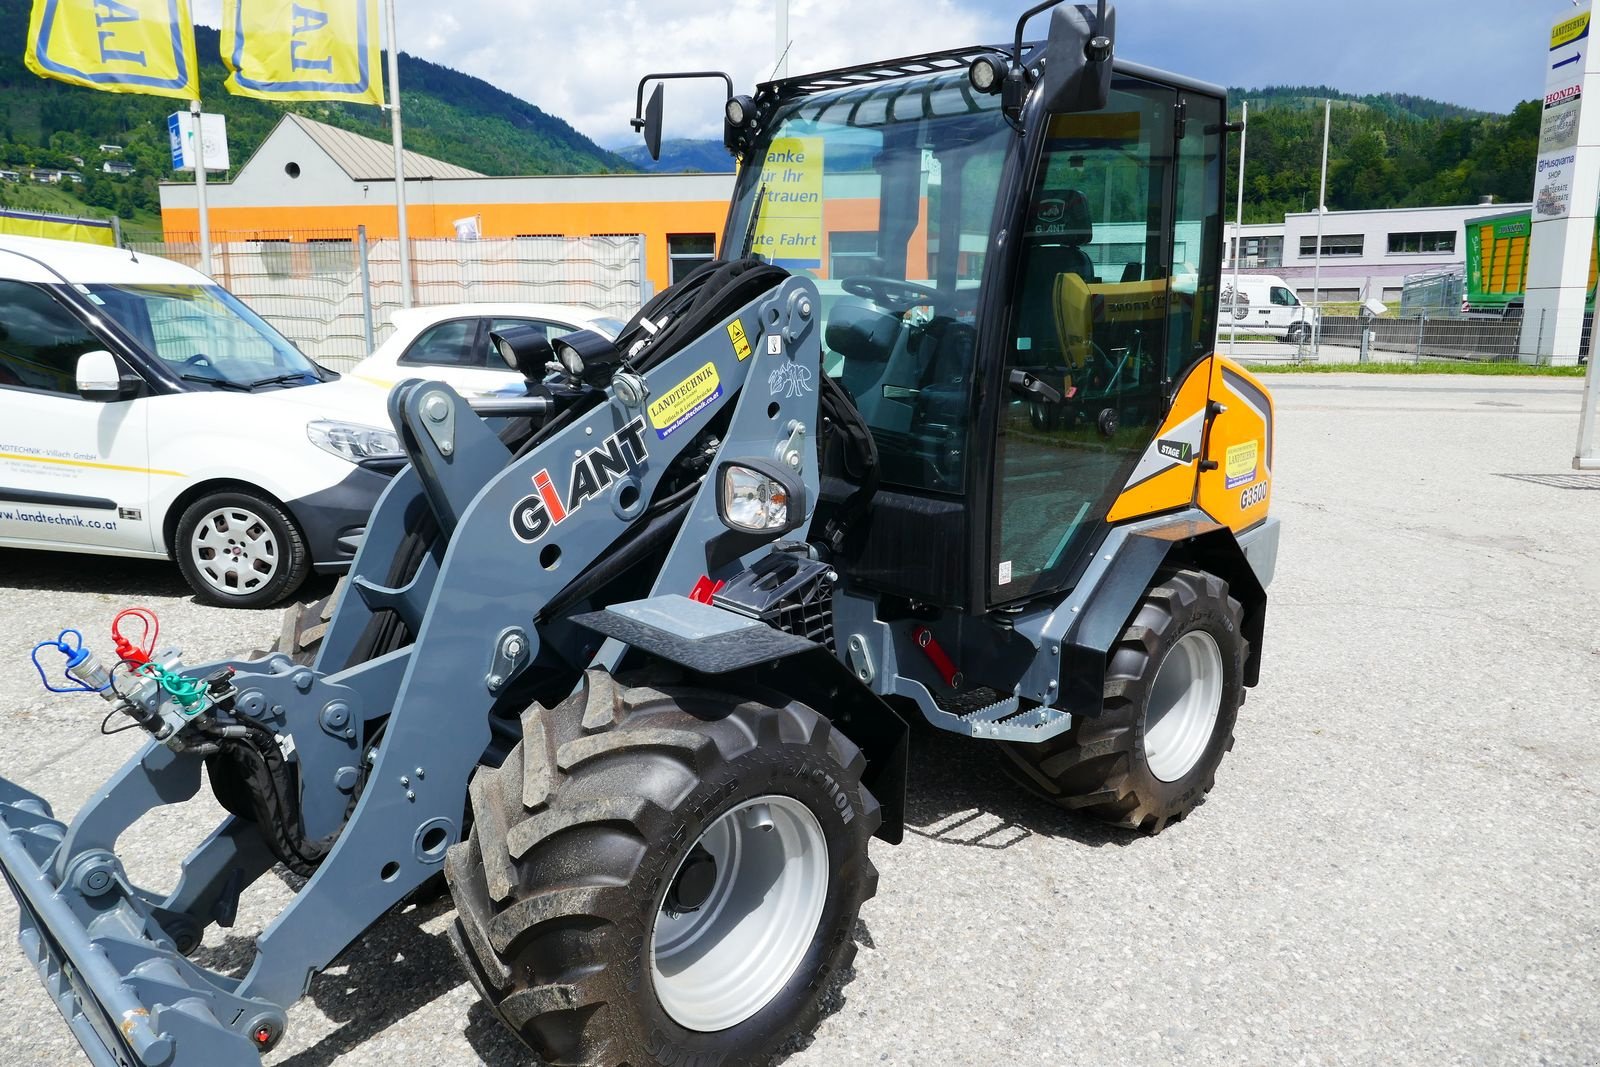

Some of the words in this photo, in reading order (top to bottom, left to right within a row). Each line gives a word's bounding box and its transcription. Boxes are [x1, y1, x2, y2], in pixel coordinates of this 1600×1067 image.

[1545, 84, 1581, 104] HONDA
[767, 149, 804, 163] anke
[1544, 155, 1575, 168] Husqvarna
[761, 168, 776, 182] ür
[783, 168, 804, 182] Ihr
[1548, 170, 1561, 179] SHOP
[1035, 223, 1066, 233] GANT
[752, 234, 774, 246] ute
[780, 233, 816, 246] Fahrt
[651, 367, 713, 417] LANDTECHNIK
[663, 392, 719, 437] www.landtechnik.co.at
[0, 444, 41, 455] NDTECHNIK
[73, 452, 97, 461] GmbH
[1161, 445, 1180, 457] STAGE
[1181, 443, 1190, 460] V
[1240, 480, 1267, 510] G3500
